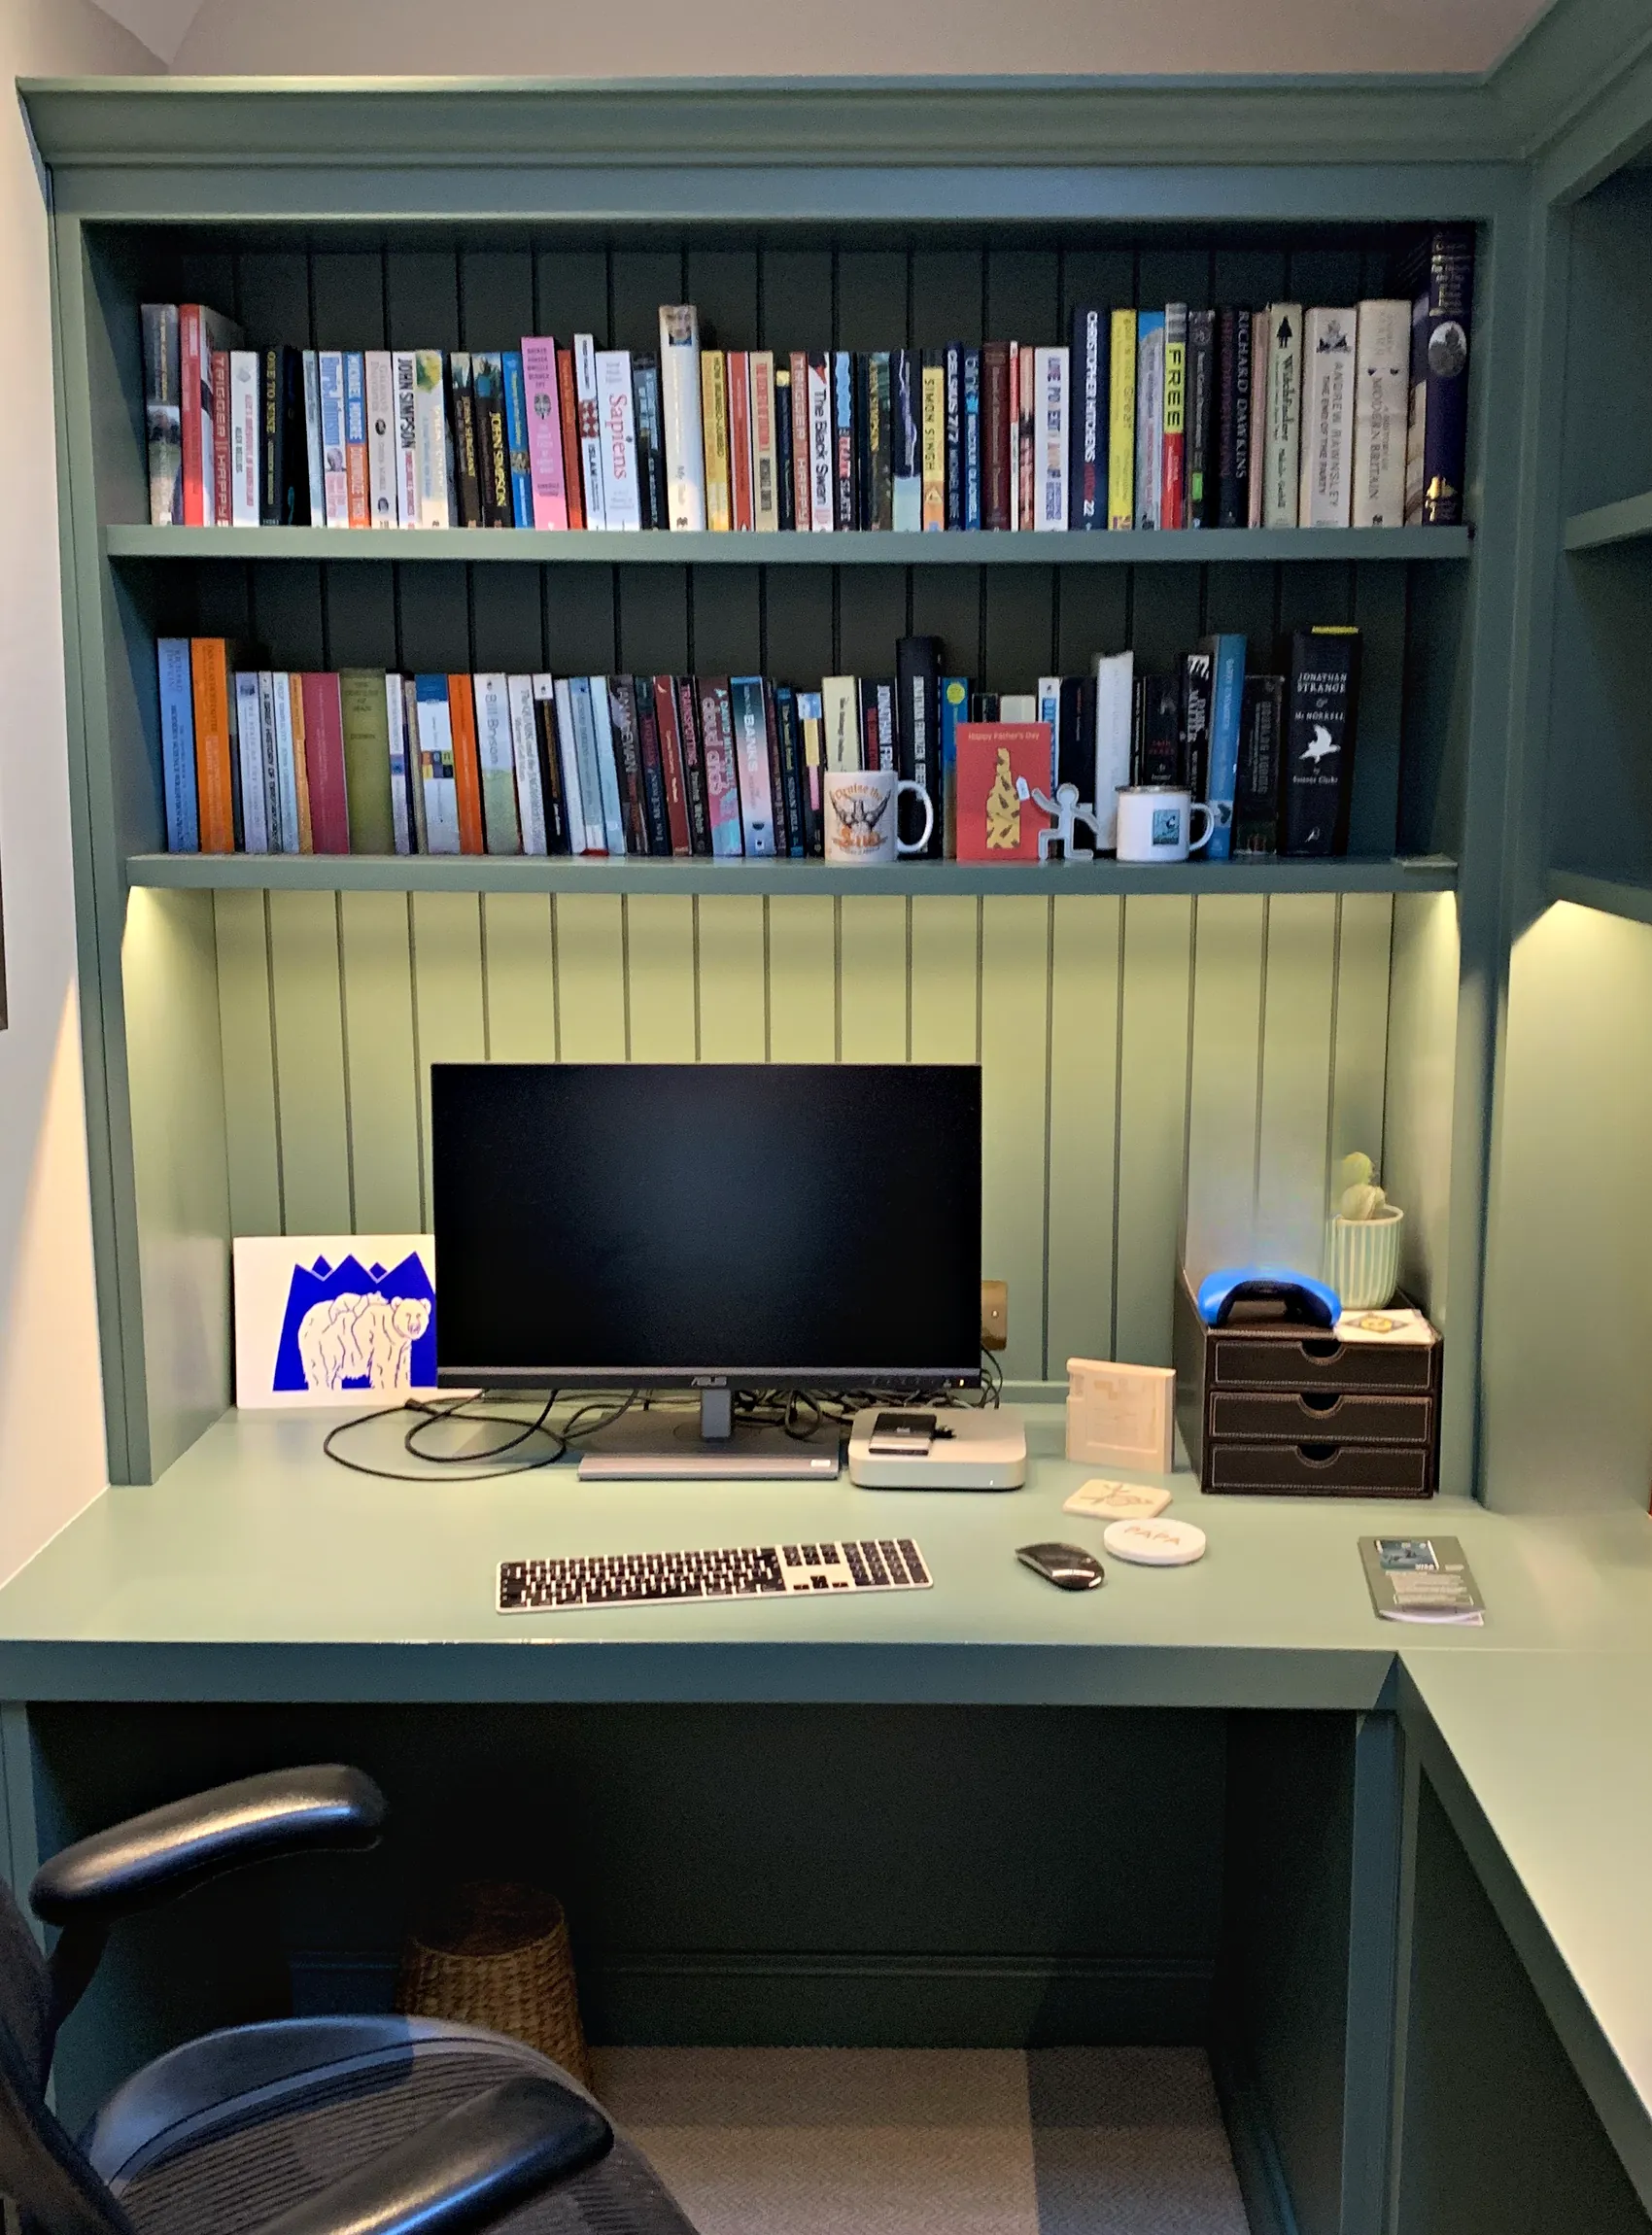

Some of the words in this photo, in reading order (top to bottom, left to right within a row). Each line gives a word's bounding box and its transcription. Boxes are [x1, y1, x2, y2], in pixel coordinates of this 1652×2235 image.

[266, 352, 276, 377] ONE
[1086, 311, 1098, 396] CHRISTOPHER
[1237, 311, 1250, 393] RICHARD
[267, 382, 276, 399] TO
[397, 358, 415, 390] JOHN
[947, 350, 958, 414] CELSIUS
[1167, 350, 1182, 428] FREE
[1322, 375, 1330, 396] THE
[1331, 361, 1344, 418] ANDREW
[216, 356, 226, 437] TRIGGER
[795, 357, 807, 440] TRIGGER
[813, 389, 827, 417] The
[924, 378, 935, 423] SIMON
[1321, 398, 1329, 420] END
[1370, 376, 1383, 441] MODERN
[399, 393, 416, 449] SIMPSON
[489, 412, 503, 448] JOHN
[604, 394, 628, 480] Sapiens
[814, 420, 828, 460] Black
[1084, 399, 1097, 463] HITCHENS
[1235, 398, 1248, 478] DAWKINS
[1321, 422, 1328, 434] OF
[924, 429, 936, 471] SINGH
[1319, 437, 1328, 459] THE
[1329, 429, 1343, 507] RAWNSLEY
[217, 454, 227, 520] HAPPY
[493, 449, 506, 506] SIMPSON
[797, 458, 808, 523] HAPPY
[815, 464, 829, 504] Swan
[1318, 461, 1327, 496] PARTY
[1368, 444, 1382, 499] BRITAIN
[1297, 682, 1345, 693] STRANGE
[1299, 672, 1347, 682] JONATHAN
[486, 693, 498, 715] Bill
[681, 683, 697, 766] TRAINSPOTTING
[702, 697, 724, 747] cloud
[720, 701, 731, 734] DAVID
[265, 729, 275, 766] HISTORY
[486, 718, 499, 766] Bryson
[743, 714, 759, 774] BANKS
[968, 731, 991, 741] Happy
[993, 731, 1023, 740] Father's
[1024, 732, 1040, 741] Day
[787, 776, 797, 808] SUSAN
[790, 809, 799, 833] HILL
[1123, 1526, 1182, 1546] PAPA
